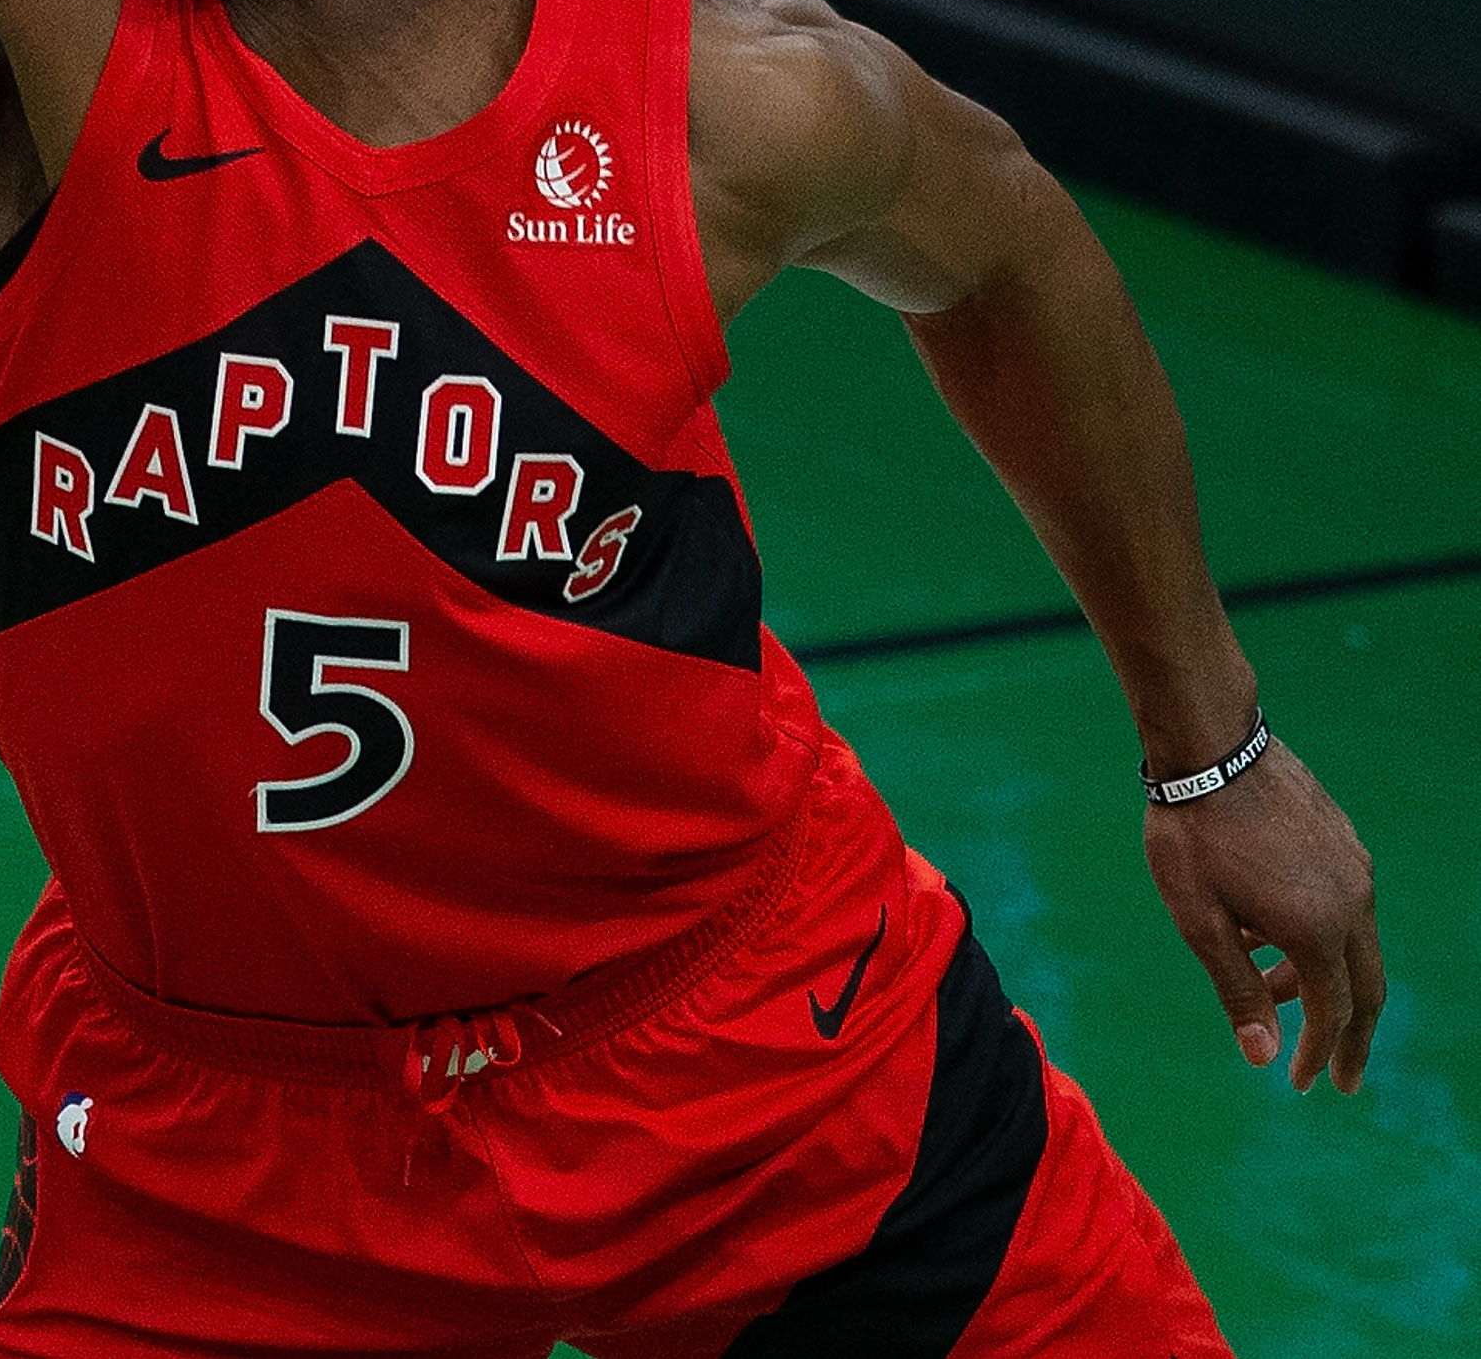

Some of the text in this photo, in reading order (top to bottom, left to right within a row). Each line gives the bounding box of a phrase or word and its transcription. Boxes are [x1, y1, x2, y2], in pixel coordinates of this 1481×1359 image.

[506, 210, 636, 246] Sun Life
[29, 313, 643, 605] RAPTORS
[256, 607, 415, 834] 5
[1165, 771, 1220, 800] LIVES
